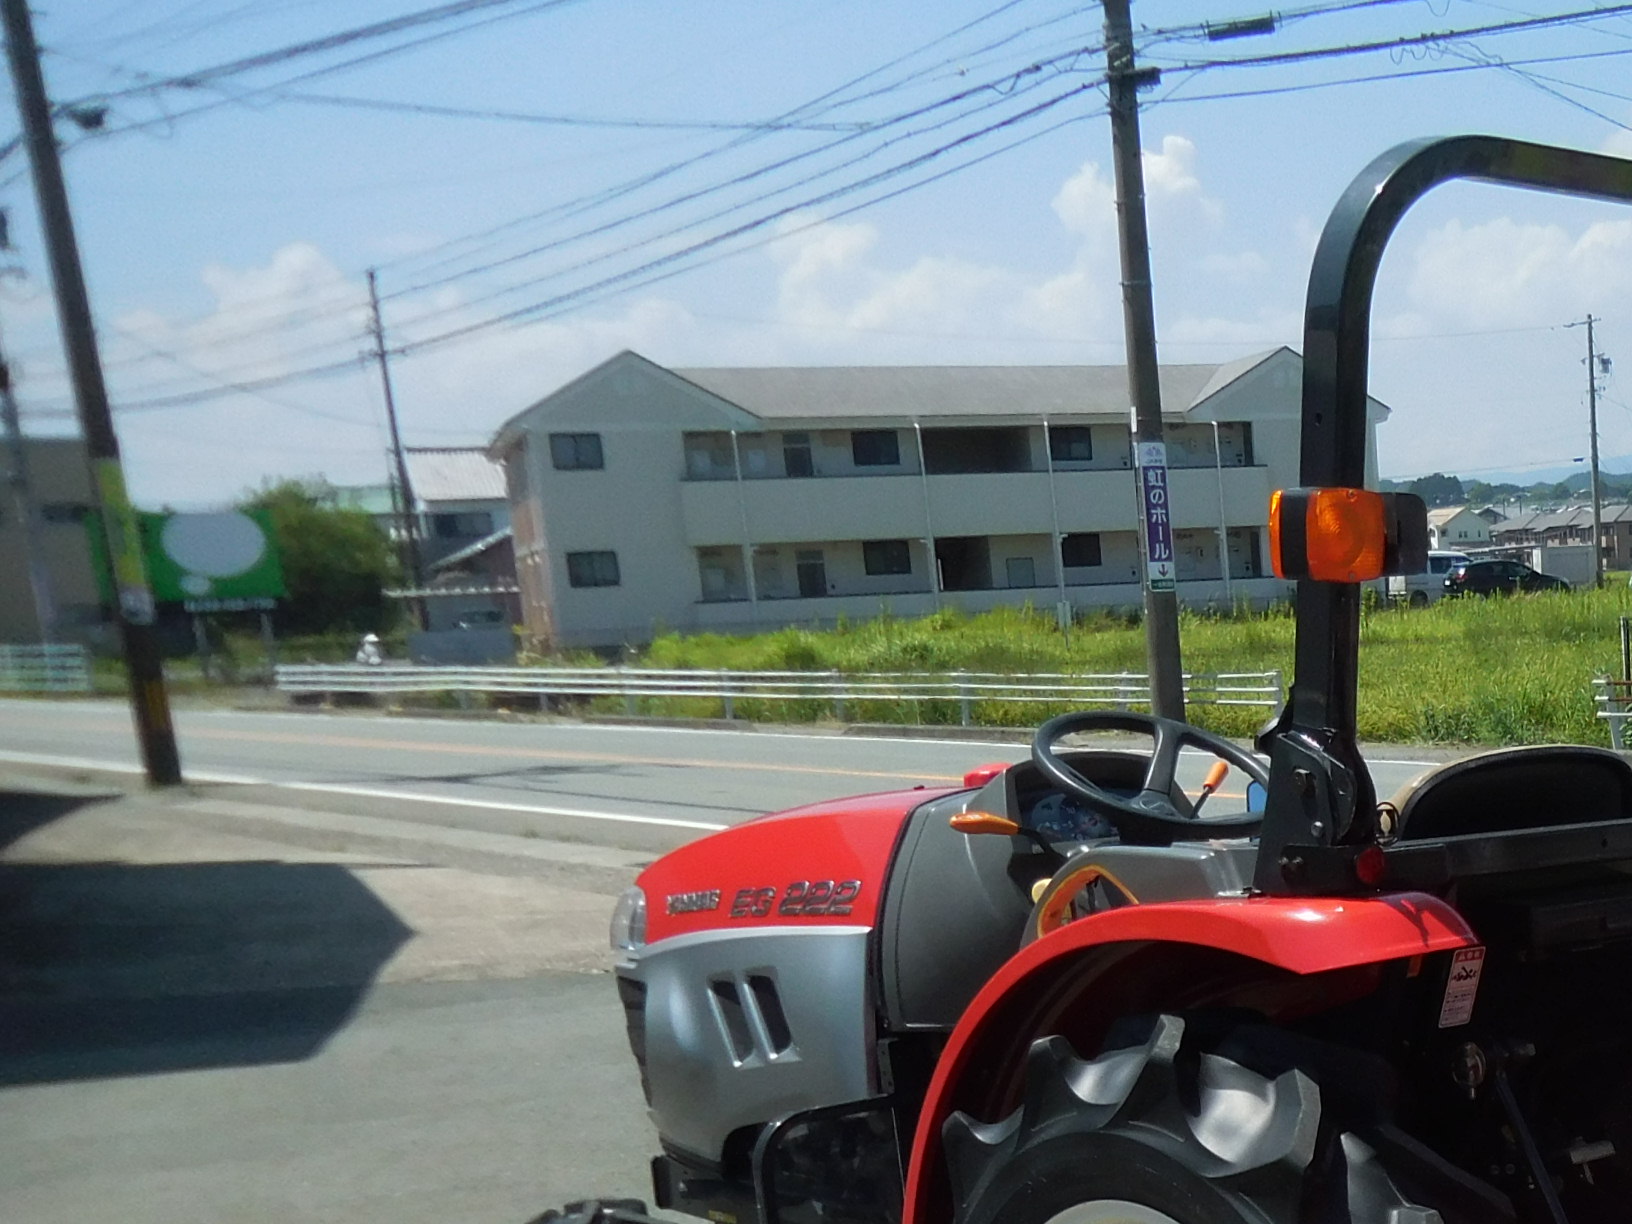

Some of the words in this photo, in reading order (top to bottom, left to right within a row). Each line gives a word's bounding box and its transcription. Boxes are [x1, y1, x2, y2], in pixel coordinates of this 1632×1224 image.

[1147, 468, 1170, 560] 虹のホール
[728, 886, 777, 918] EG
[778, 880, 862, 916] 222
